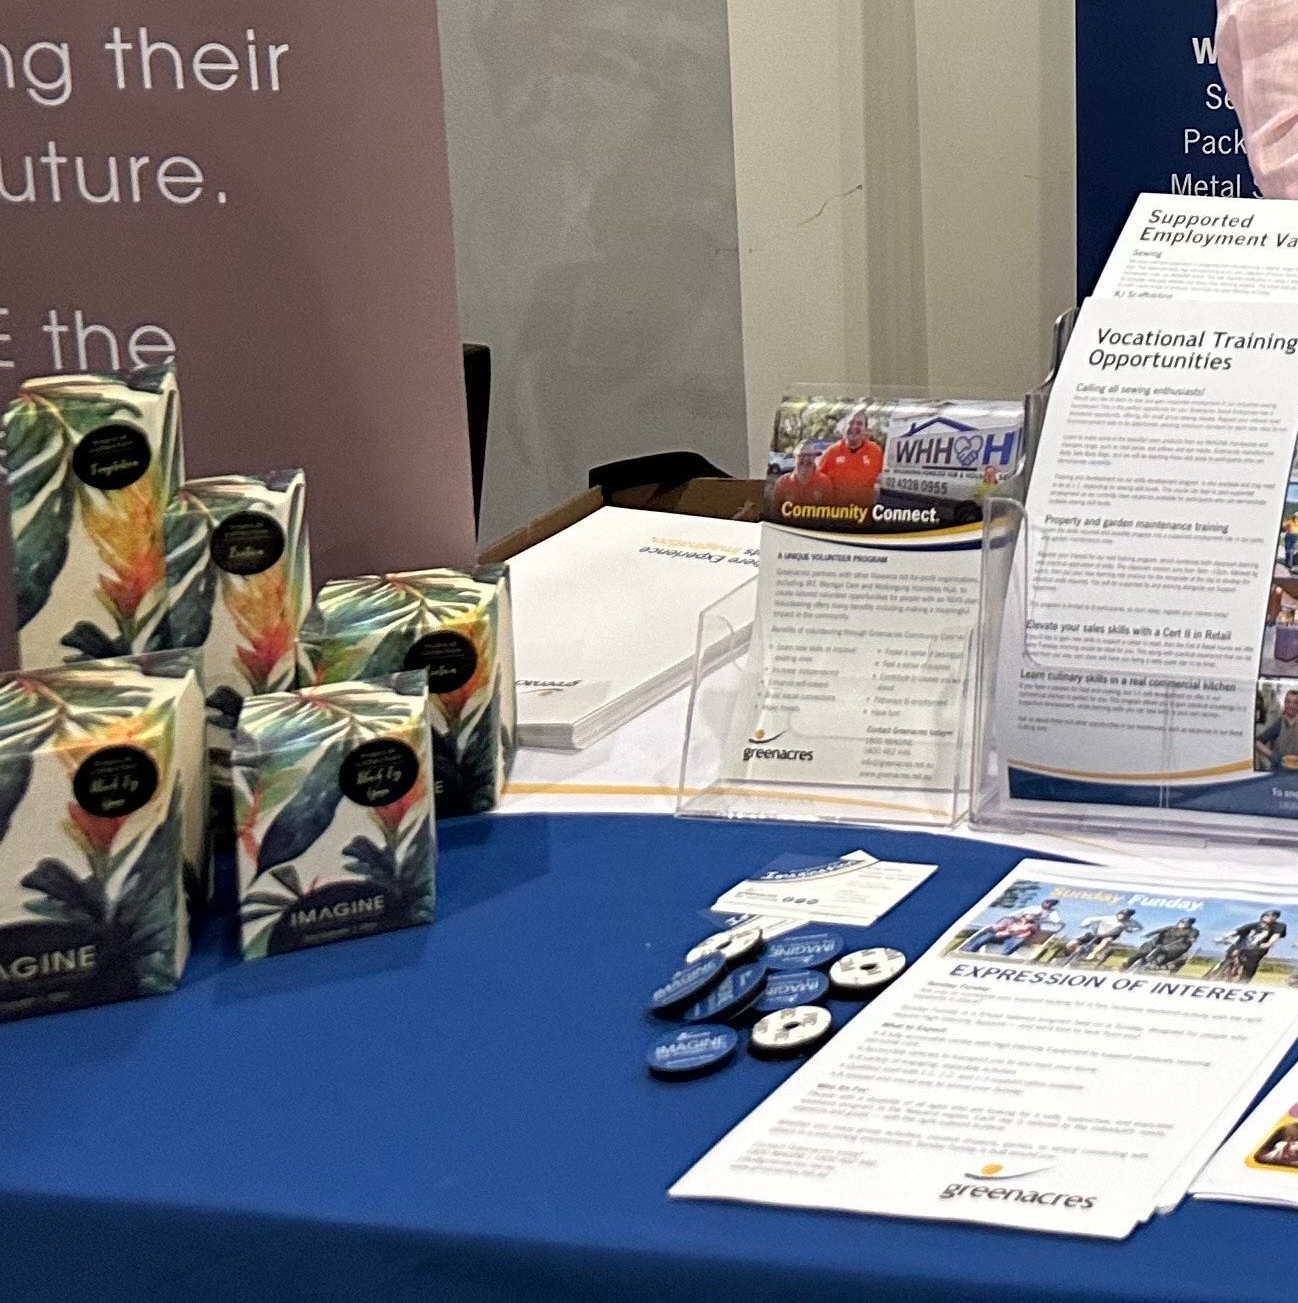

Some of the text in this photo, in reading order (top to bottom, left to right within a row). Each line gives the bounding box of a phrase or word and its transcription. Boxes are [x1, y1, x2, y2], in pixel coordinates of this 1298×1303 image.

[104, 27, 289, 92] their
[1171, 173, 1242, 198] Metal
[1148, 209, 1255, 229] Supported
[1139, 226, 1268, 248] Employment
[43, 309, 177, 370] the
[1097, 328, 1205, 349] Vocational
[1213, 331, 1298, 355] Training
[1088, 350, 1232, 371] Opportunities
[1076, 382, 1105, 395] Calling
[1121, 385, 1151, 396] sewing
[782, 501, 940, 524] Community Connect.
[1045, 514, 1229, 534] Property and garden maintenance training
[1061, 623, 1081, 633] your
[1083, 623, 1105, 634] sales
[1108, 624, 1130, 634] skills
[1133, 625, 1152, 636] with
[1163, 627, 1181, 638] Cert
[1205, 629, 1232, 640] Retail
[1020, 669, 1045, 679] Learn
[1048, 670, 1082, 683] culinary
[1085, 672, 1108, 684] skills
[1110, 675, 1119, 684] in
[1130, 676, 1146, 686] real
[743, 748, 814, 761] greenacres
[290, 895, 385, 926] IMAGINE
[1127, 894, 1204, 912] Funday
[949, 964, 1275, 1004] EXPRESSION OF INTEREST
[938, 1181, 1097, 1211] greenacres
